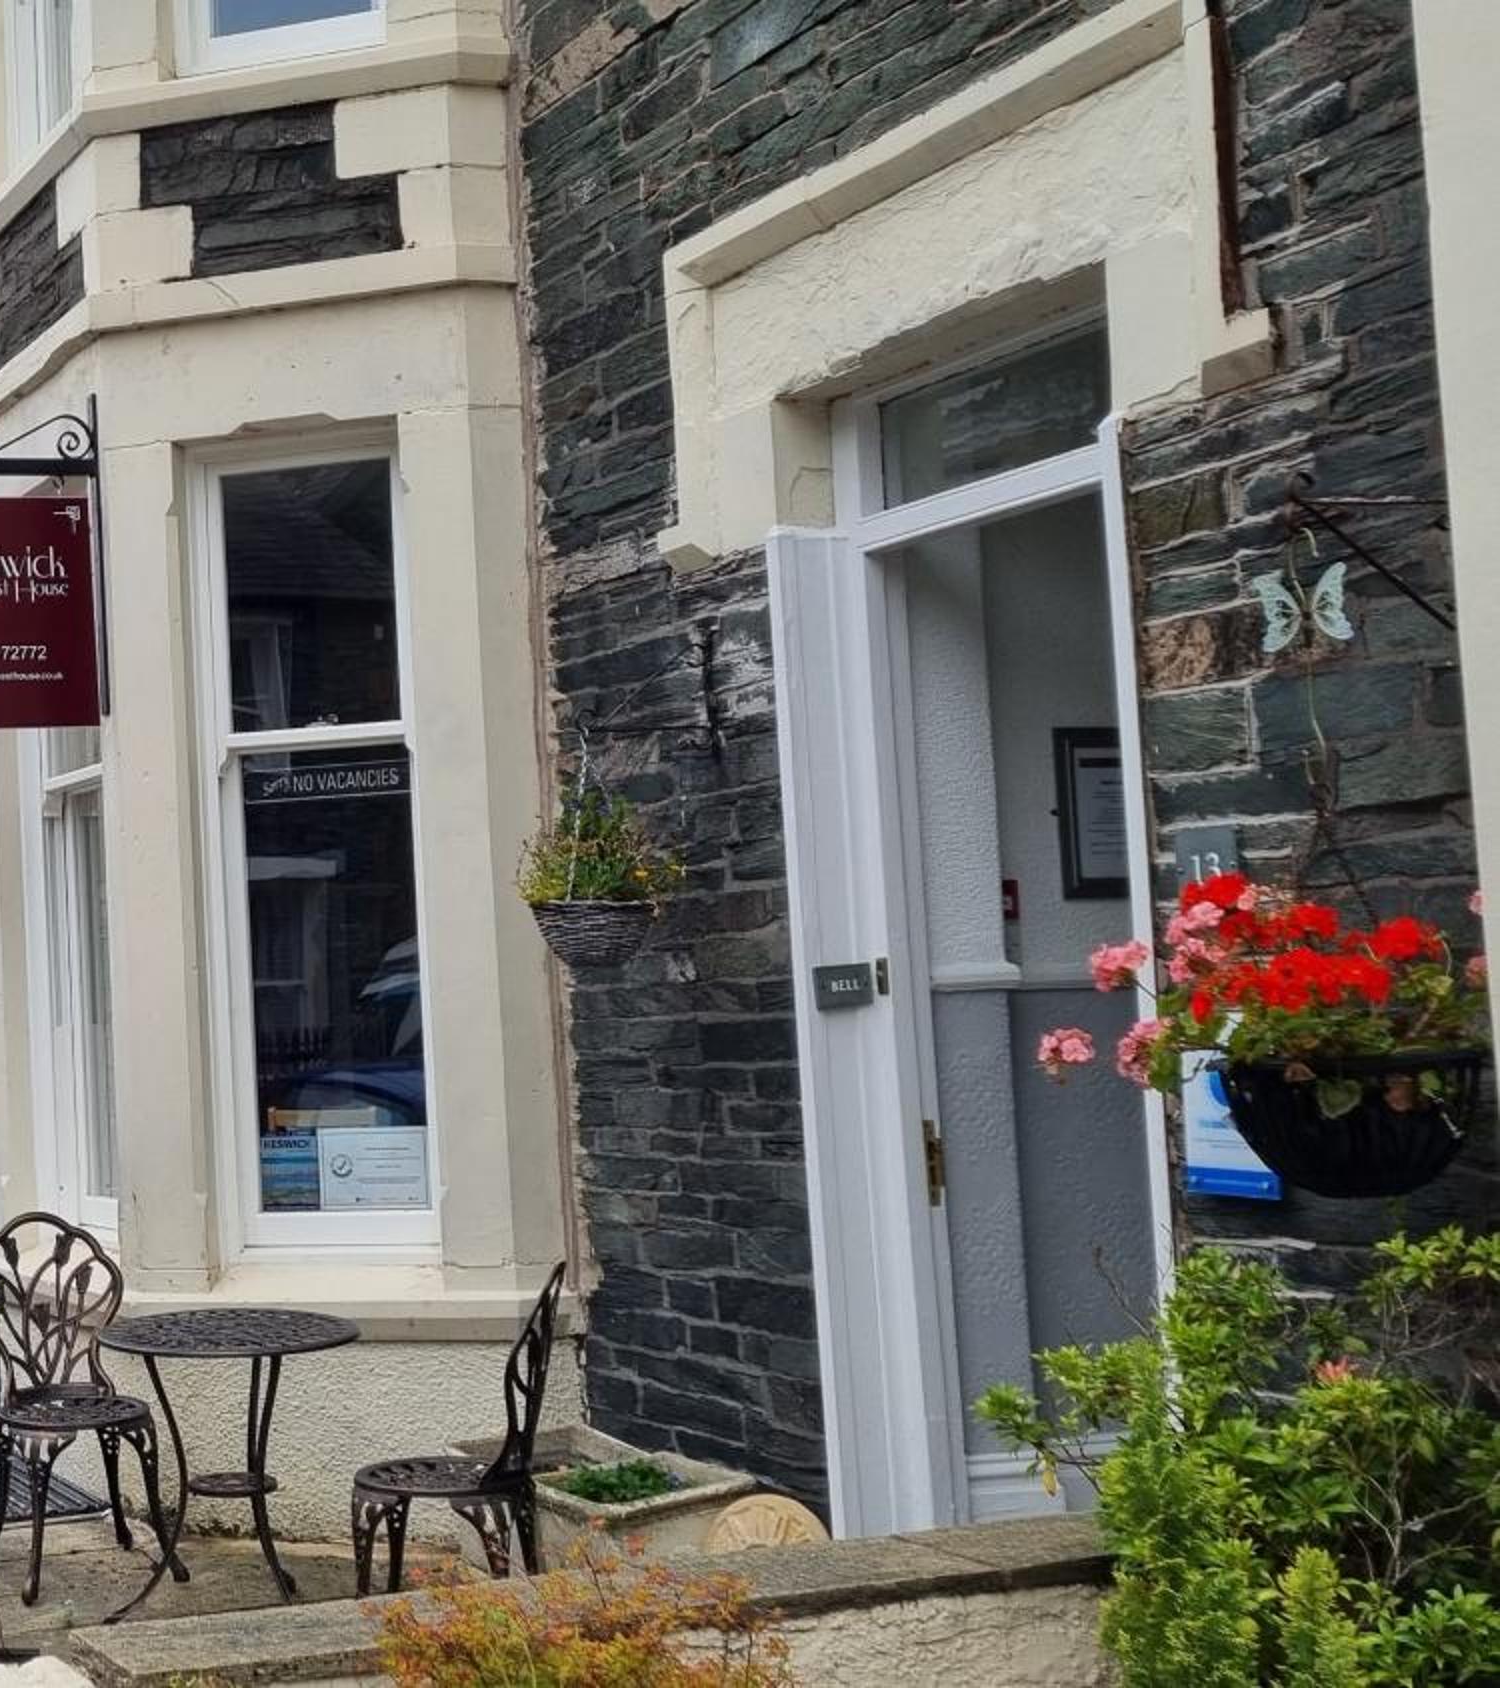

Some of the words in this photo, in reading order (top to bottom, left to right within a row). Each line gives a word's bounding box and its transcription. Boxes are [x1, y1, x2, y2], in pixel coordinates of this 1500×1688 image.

[15, 578, 69, 604] House
[1, 645, 48, 661] 72772
[293, 774, 314, 793] NO
[316, 767, 400, 791] VACANCIES
[831, 978, 860, 992] BELL
